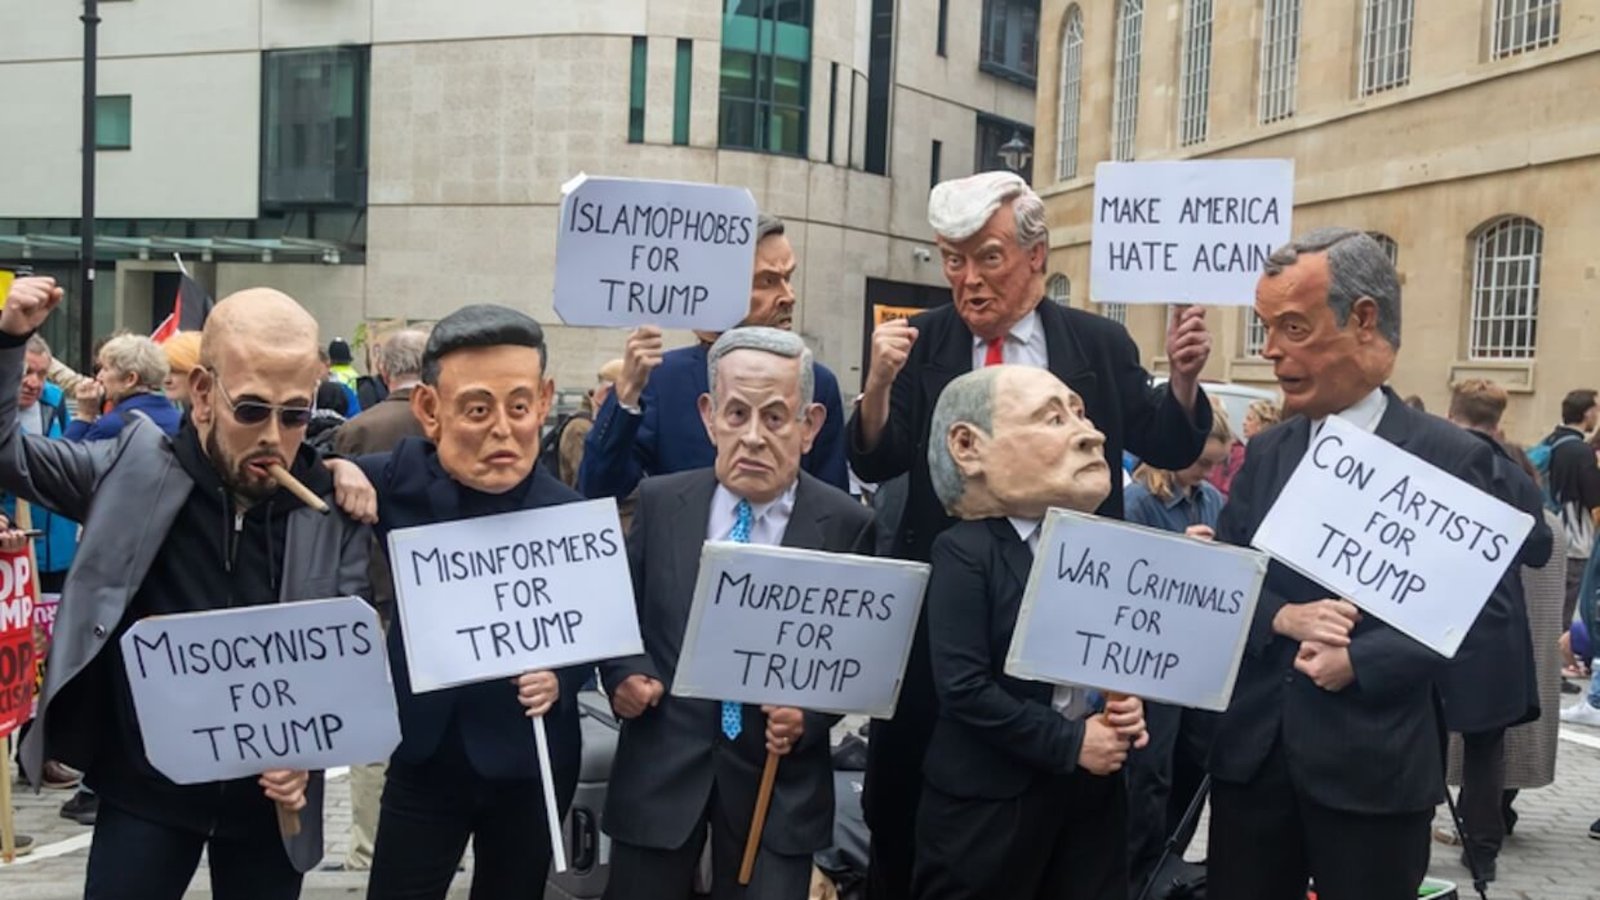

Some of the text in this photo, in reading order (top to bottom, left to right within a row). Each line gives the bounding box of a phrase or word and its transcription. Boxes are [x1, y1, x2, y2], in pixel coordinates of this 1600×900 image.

[569, 196, 753, 246] ISLAMOPHOBES
[1100, 196, 1280, 225] MAKE AMERICA
[630, 244, 680, 273] FOR
[1109, 241, 1271, 273] HATE AGAIN
[599, 278, 709, 316] TRUMP
[1312, 435, 1509, 562] CON ARTISTS
[1364, 511, 1417, 556] FOR
[411, 528, 618, 587] MISINFORMERS
[1057, 542, 1244, 615] WAR CRIMINALS
[1316, 522, 1427, 604] TRUMP
[494, 576, 553, 612] FOR
[713, 570, 896, 621] MURDERERS
[456, 609, 583, 661] TRUMP
[776, 621, 834, 651] FOR
[1114, 605, 1162, 635] FOR
[133, 621, 372, 679] MISOGYNISTS
[733, 649, 861, 693] TRUMP
[1076, 630, 1180, 681] TRUMP
[229, 678, 297, 713] FOR
[192, 713, 344, 762] TRUMP
